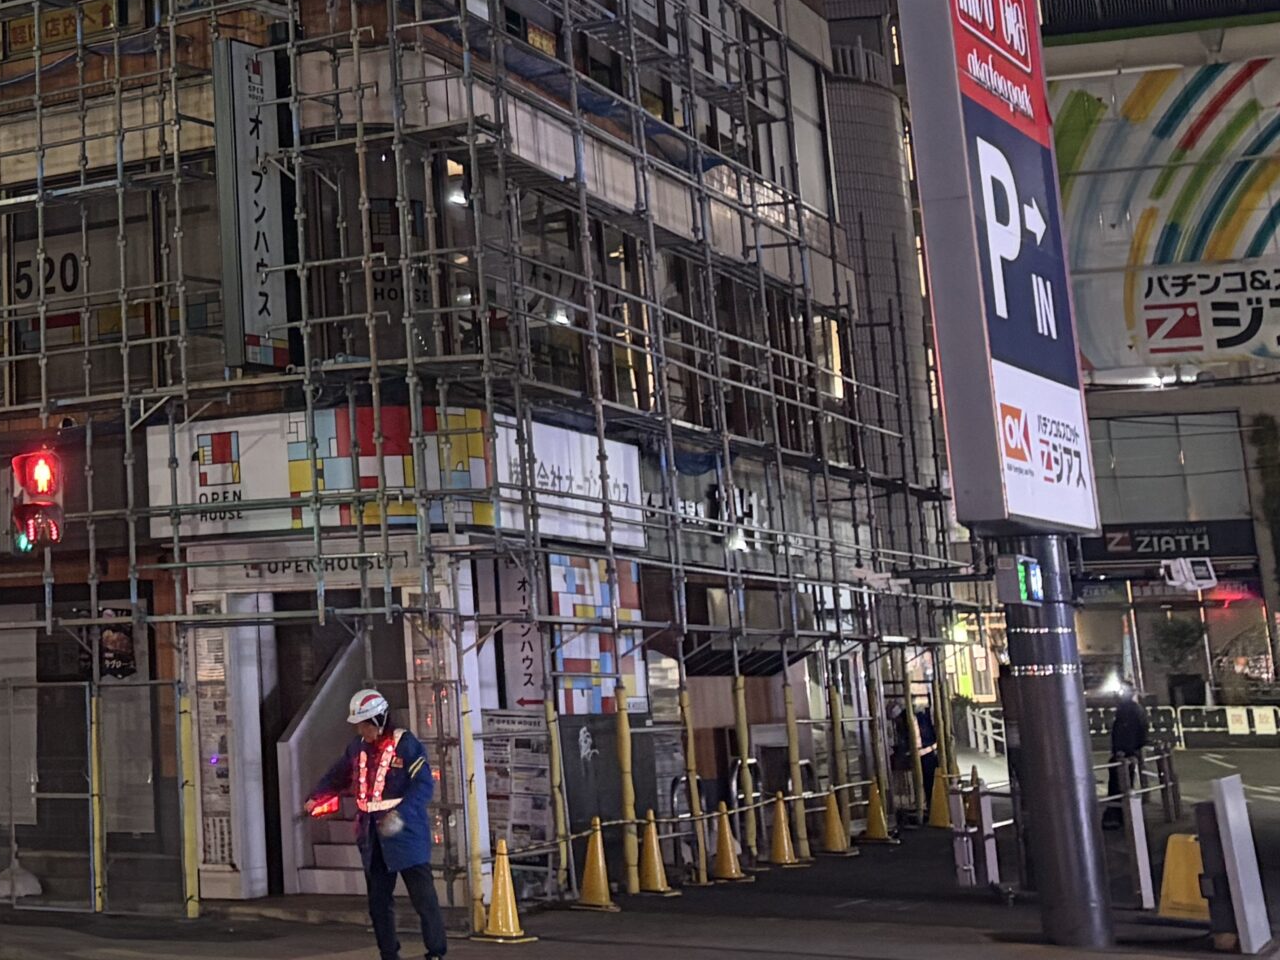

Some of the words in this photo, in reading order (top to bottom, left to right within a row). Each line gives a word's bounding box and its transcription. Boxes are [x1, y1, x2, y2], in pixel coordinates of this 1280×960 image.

[249, 116, 271, 317] オープンハウス
[976, 135, 1022, 320] P
[372, 269, 429, 285] OPN
[1031, 273, 1058, 340] IN
[198, 489, 243, 506] OPEN
[1135, 534, 1210, 552] ZIATH
[267, 557, 320, 575] OPEN
